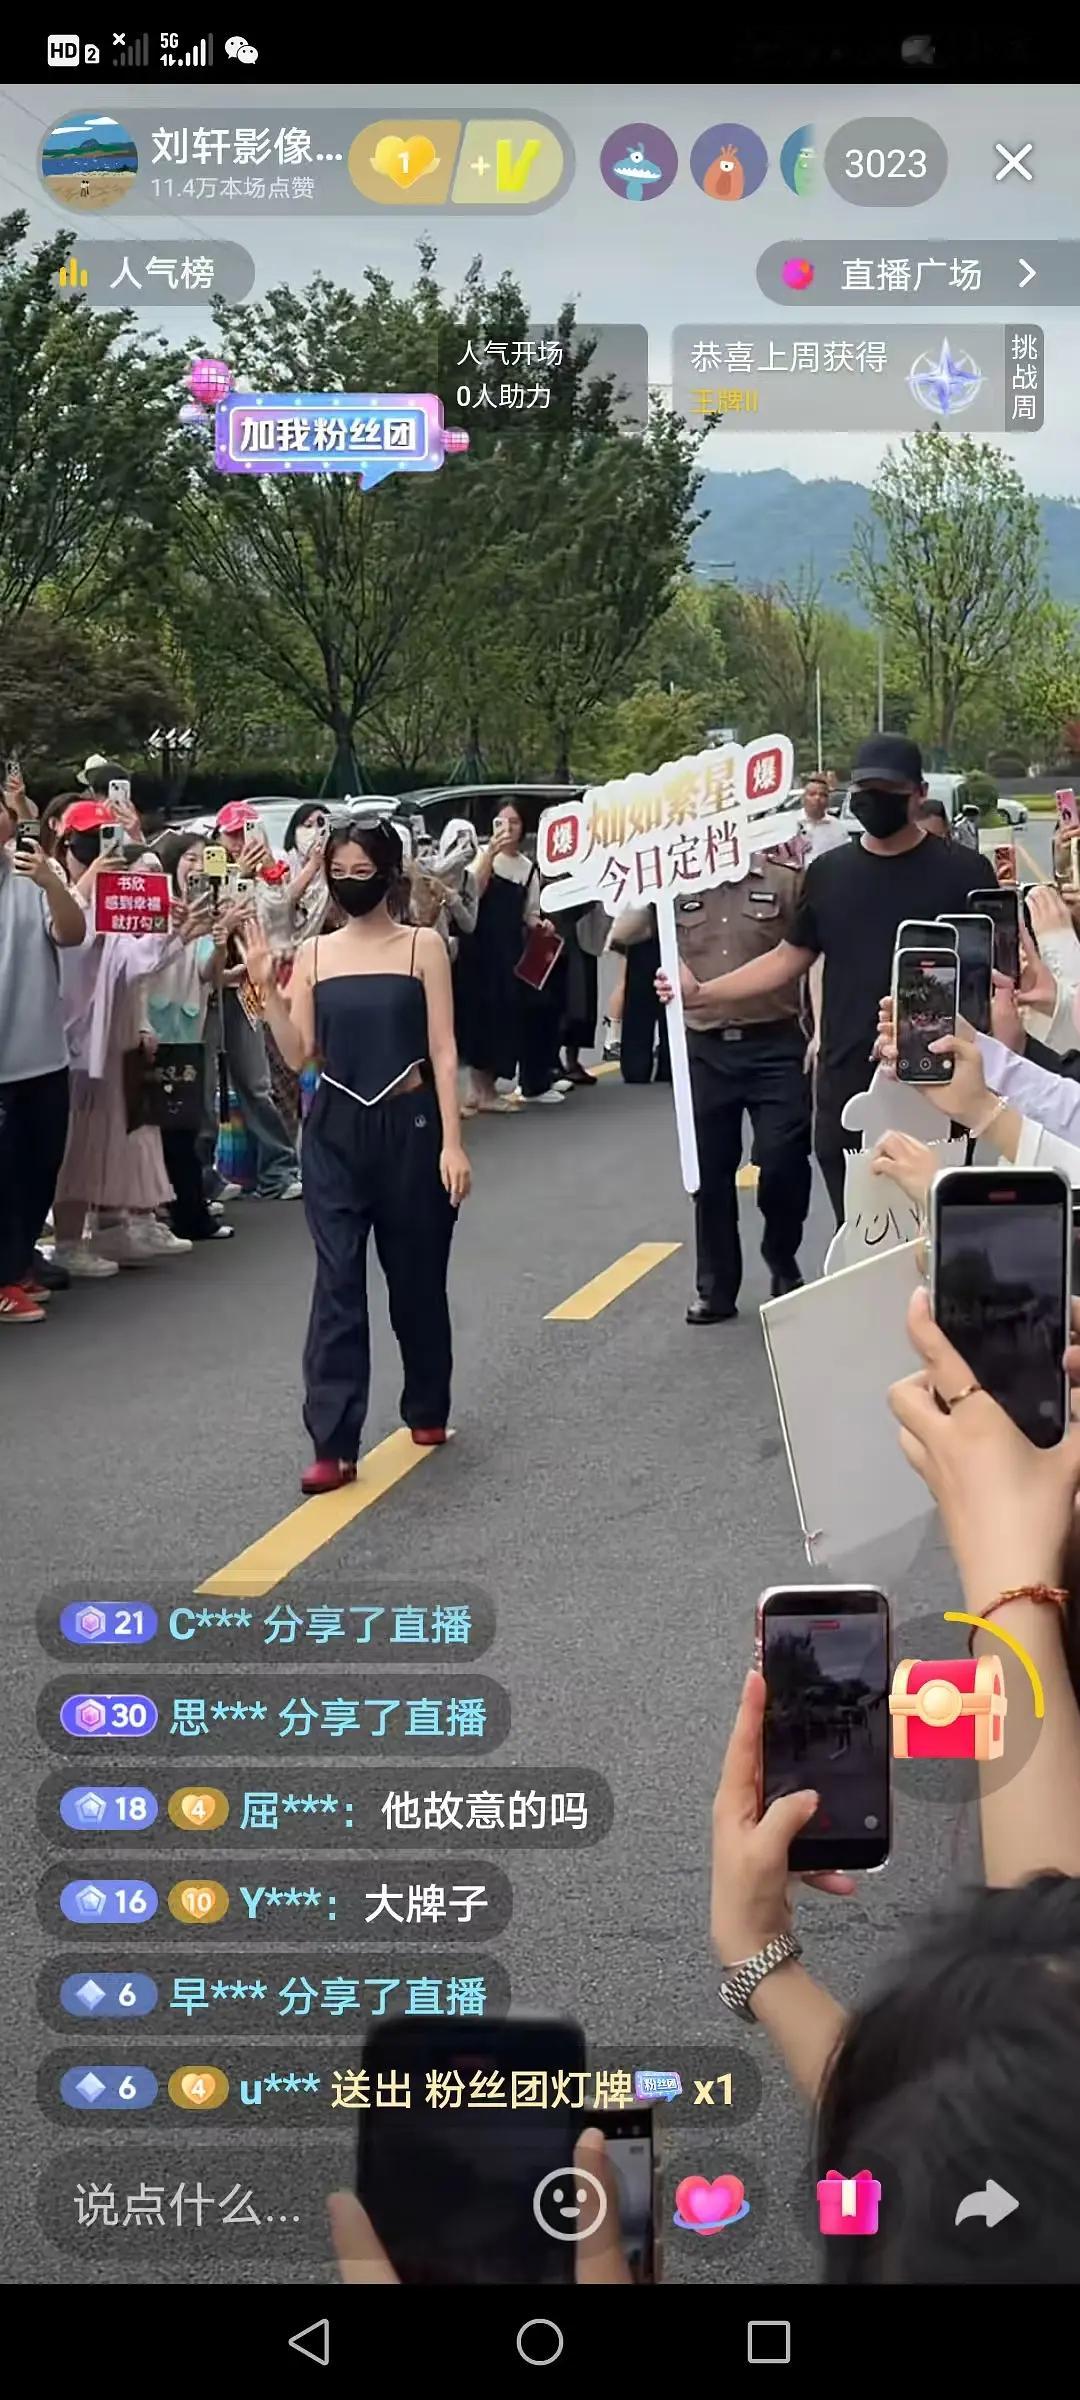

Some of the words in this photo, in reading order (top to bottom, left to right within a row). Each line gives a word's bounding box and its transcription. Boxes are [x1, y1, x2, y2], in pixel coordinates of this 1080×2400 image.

[752, 758, 777, 792] 爆
[551, 822, 574, 857] 爆
[581, 757, 741, 864] 灿如繁星
[596, 819, 740, 903] 今日定档
